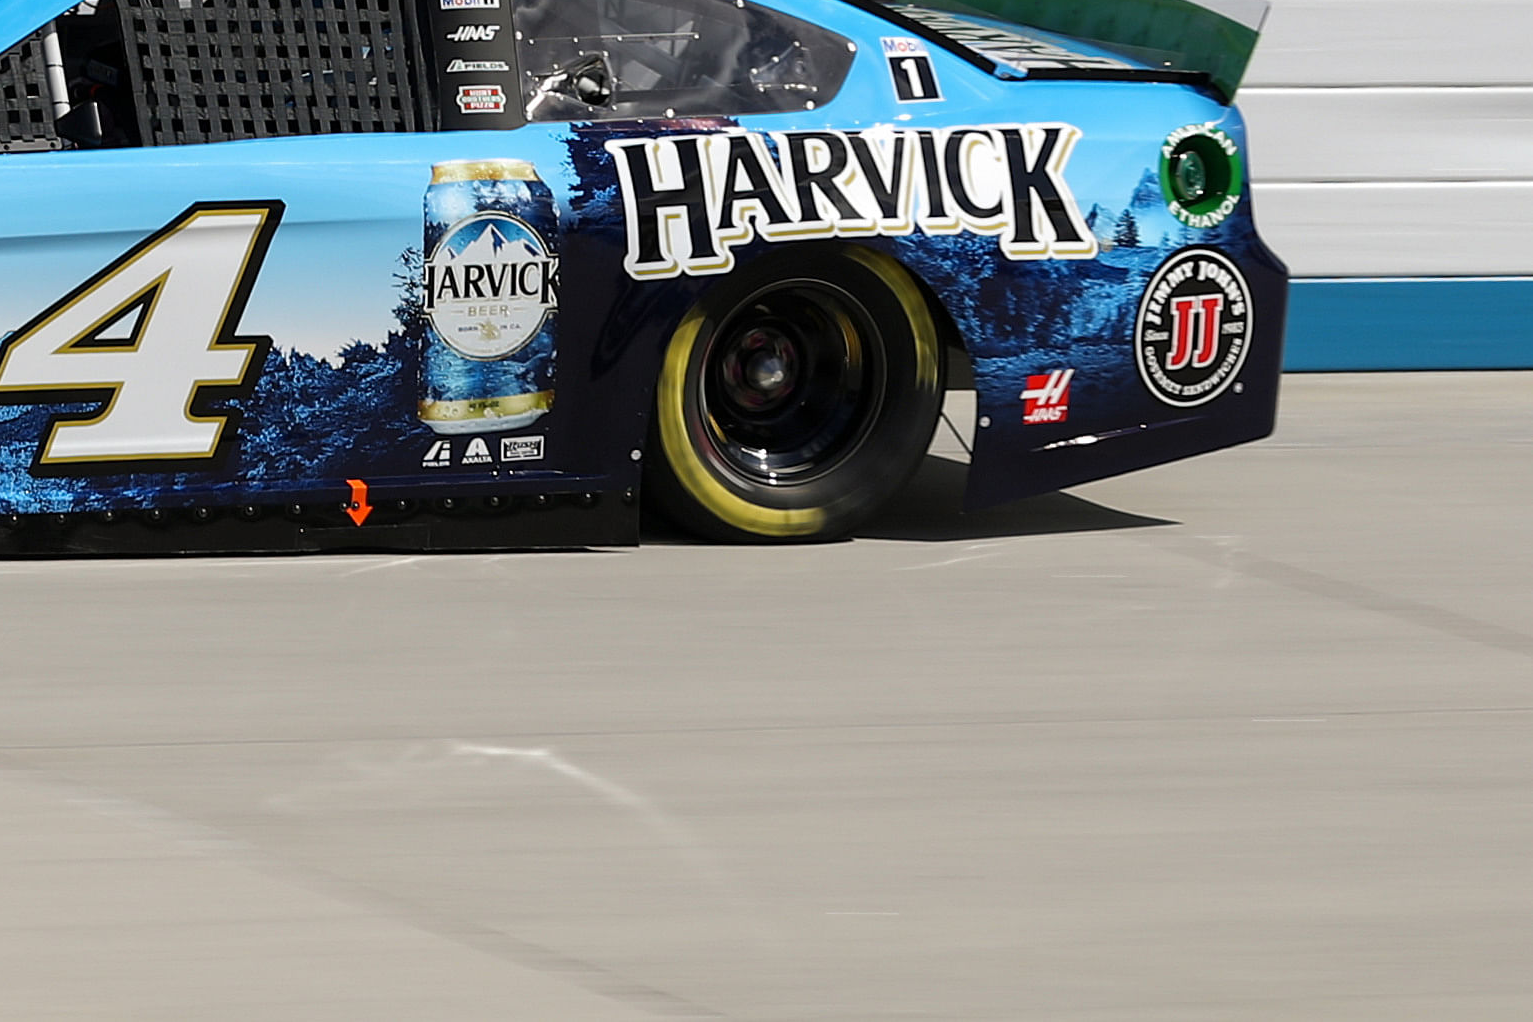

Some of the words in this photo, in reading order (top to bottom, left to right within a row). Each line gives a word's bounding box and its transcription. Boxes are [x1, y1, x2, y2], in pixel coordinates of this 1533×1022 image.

[447, 26, 501, 42] HAAS
[900, 58, 925, 98] 1
[609, 125, 1089, 273] HARVICK
[1169, 195, 1241, 228] ETHANOL
[468, 304, 509, 317] BEER
[1145, 261, 1195, 326] JIMMY
[1165, 293, 1224, 370] JJ
[1023, 406, 1068, 422] HAAS
